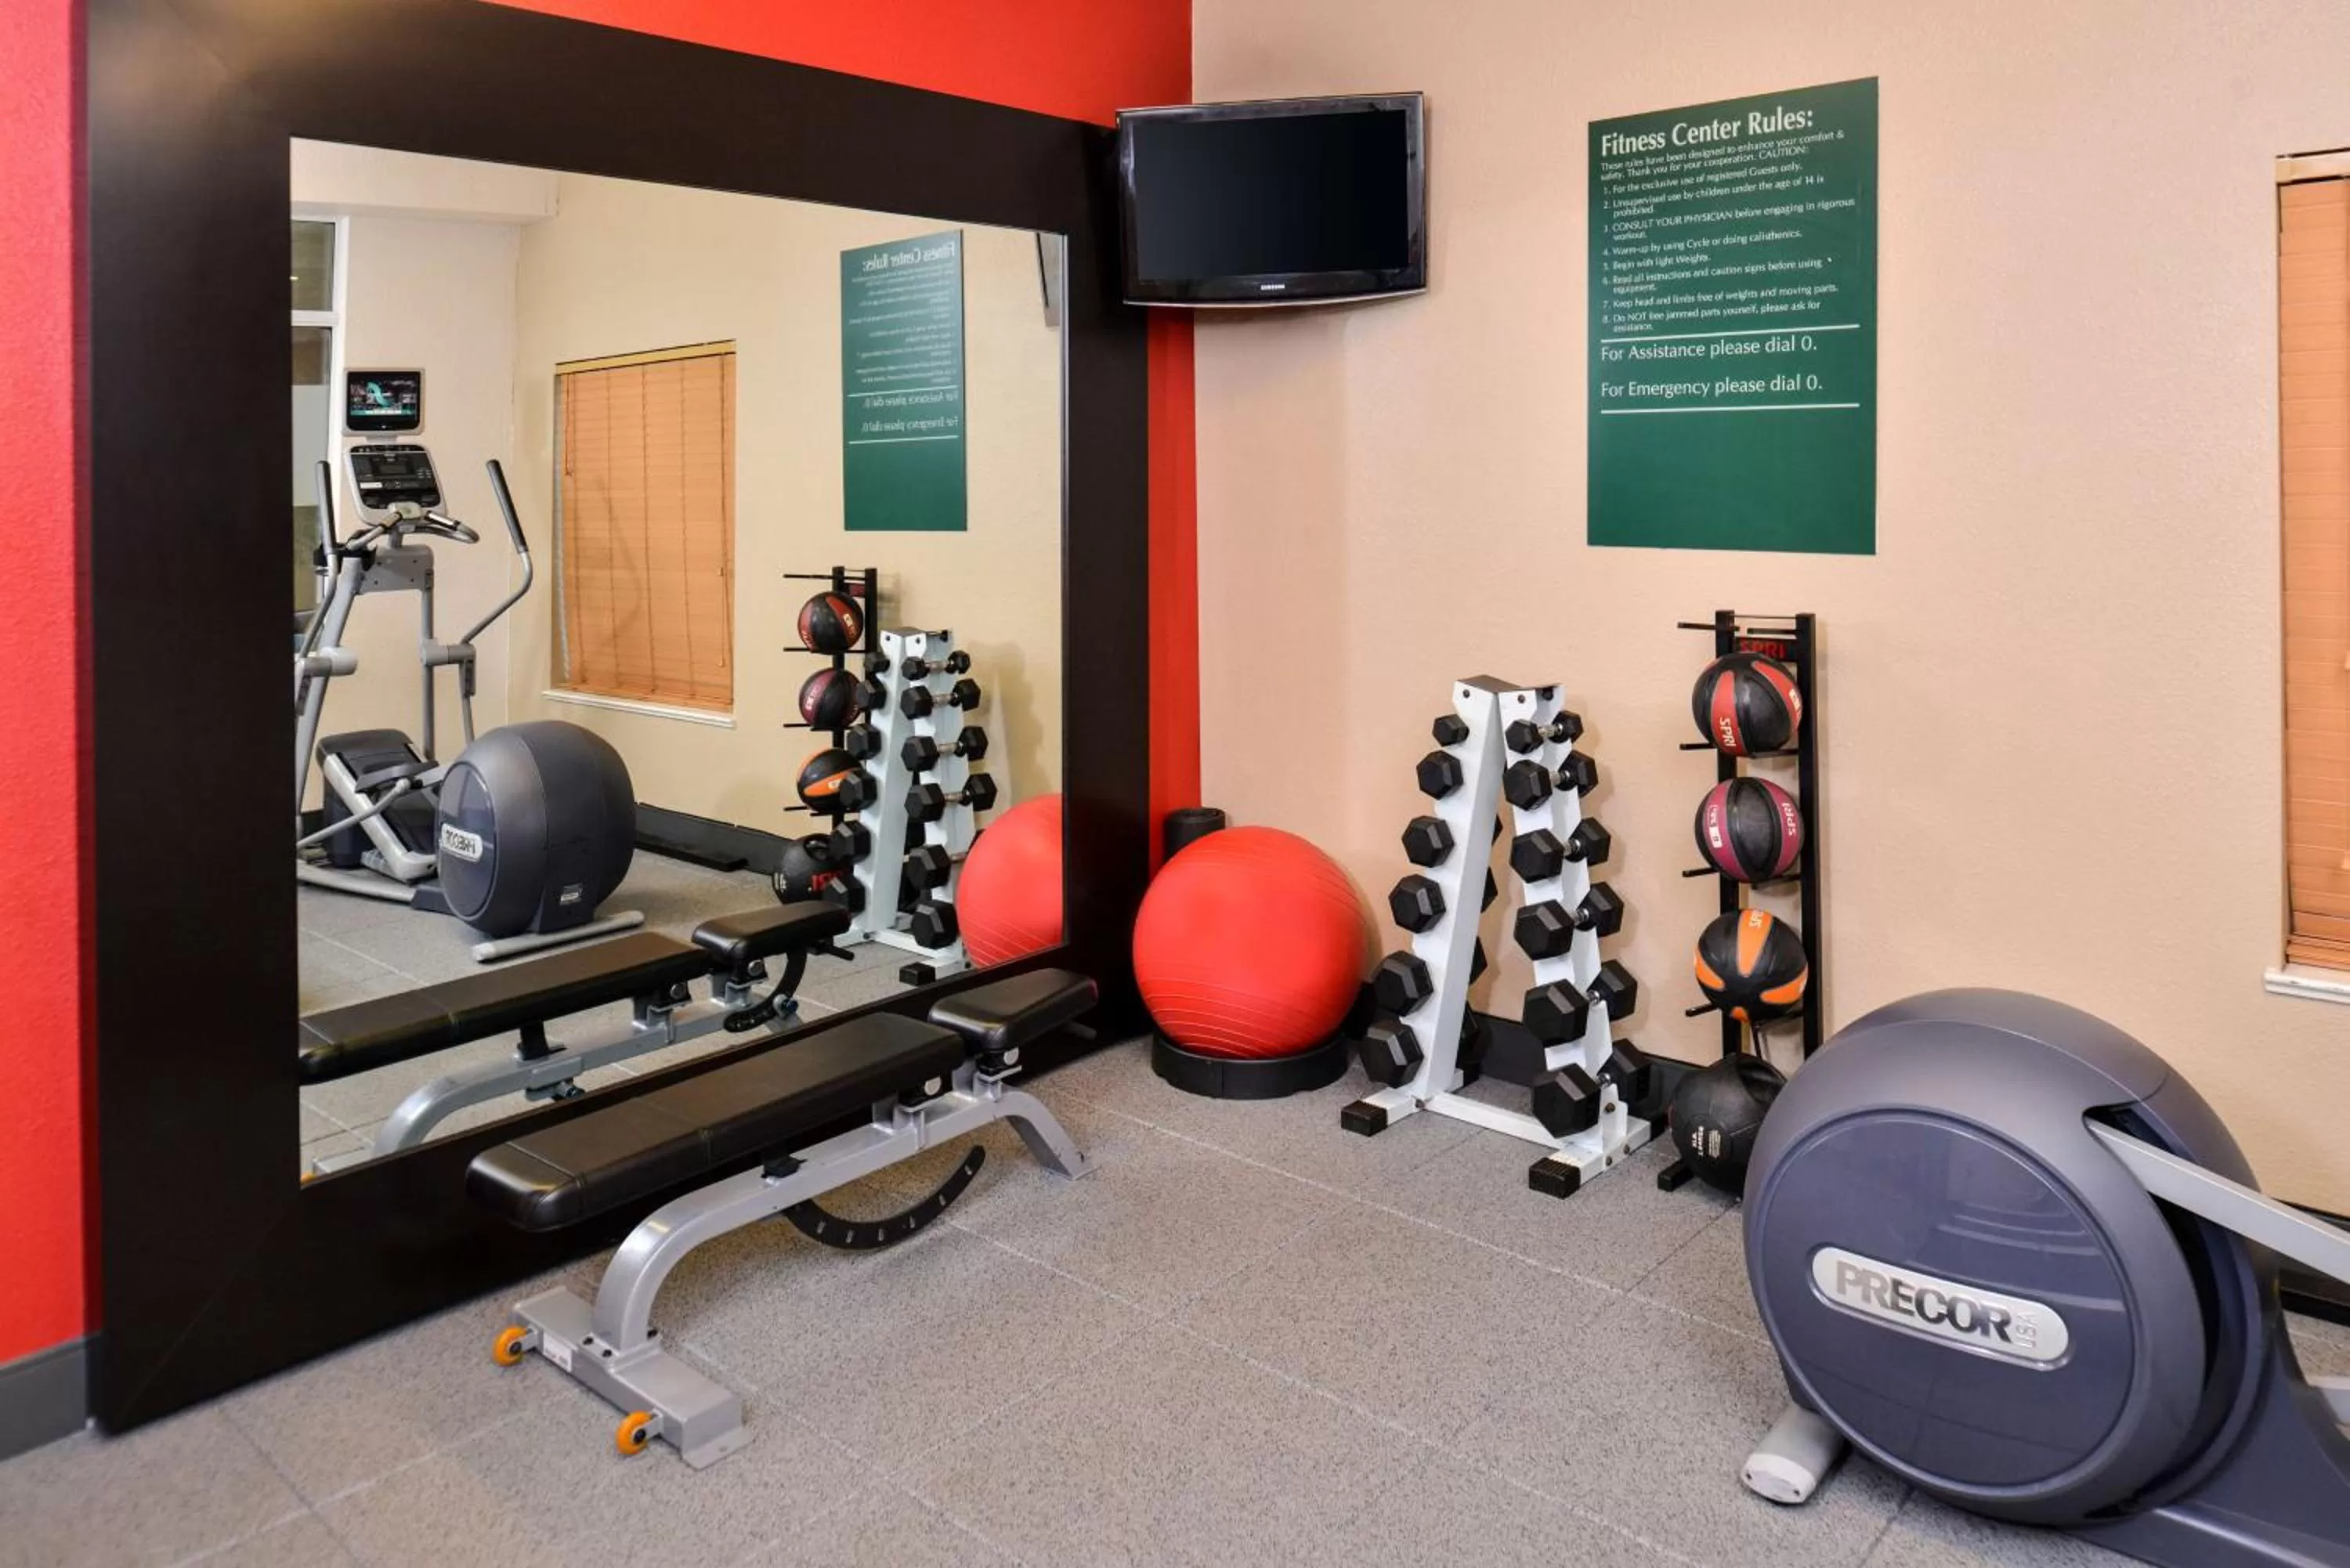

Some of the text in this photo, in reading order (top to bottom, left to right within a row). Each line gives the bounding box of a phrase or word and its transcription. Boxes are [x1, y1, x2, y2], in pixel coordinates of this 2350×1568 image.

[1602, 106, 1813, 157] Fitness Center Rules:
[1601, 334, 1817, 361] For Assistance please dial 0.
[1601, 373, 1823, 399] For Emergency please dial 0.
[1739, 639, 1786, 659] SPRI
[1719, 717, 1737, 747] SPRI
[1781, 802, 1796, 836] SPRI
[1835, 1259, 2012, 1343] PRECOR
[2016, 1310, 2037, 1349] USA
